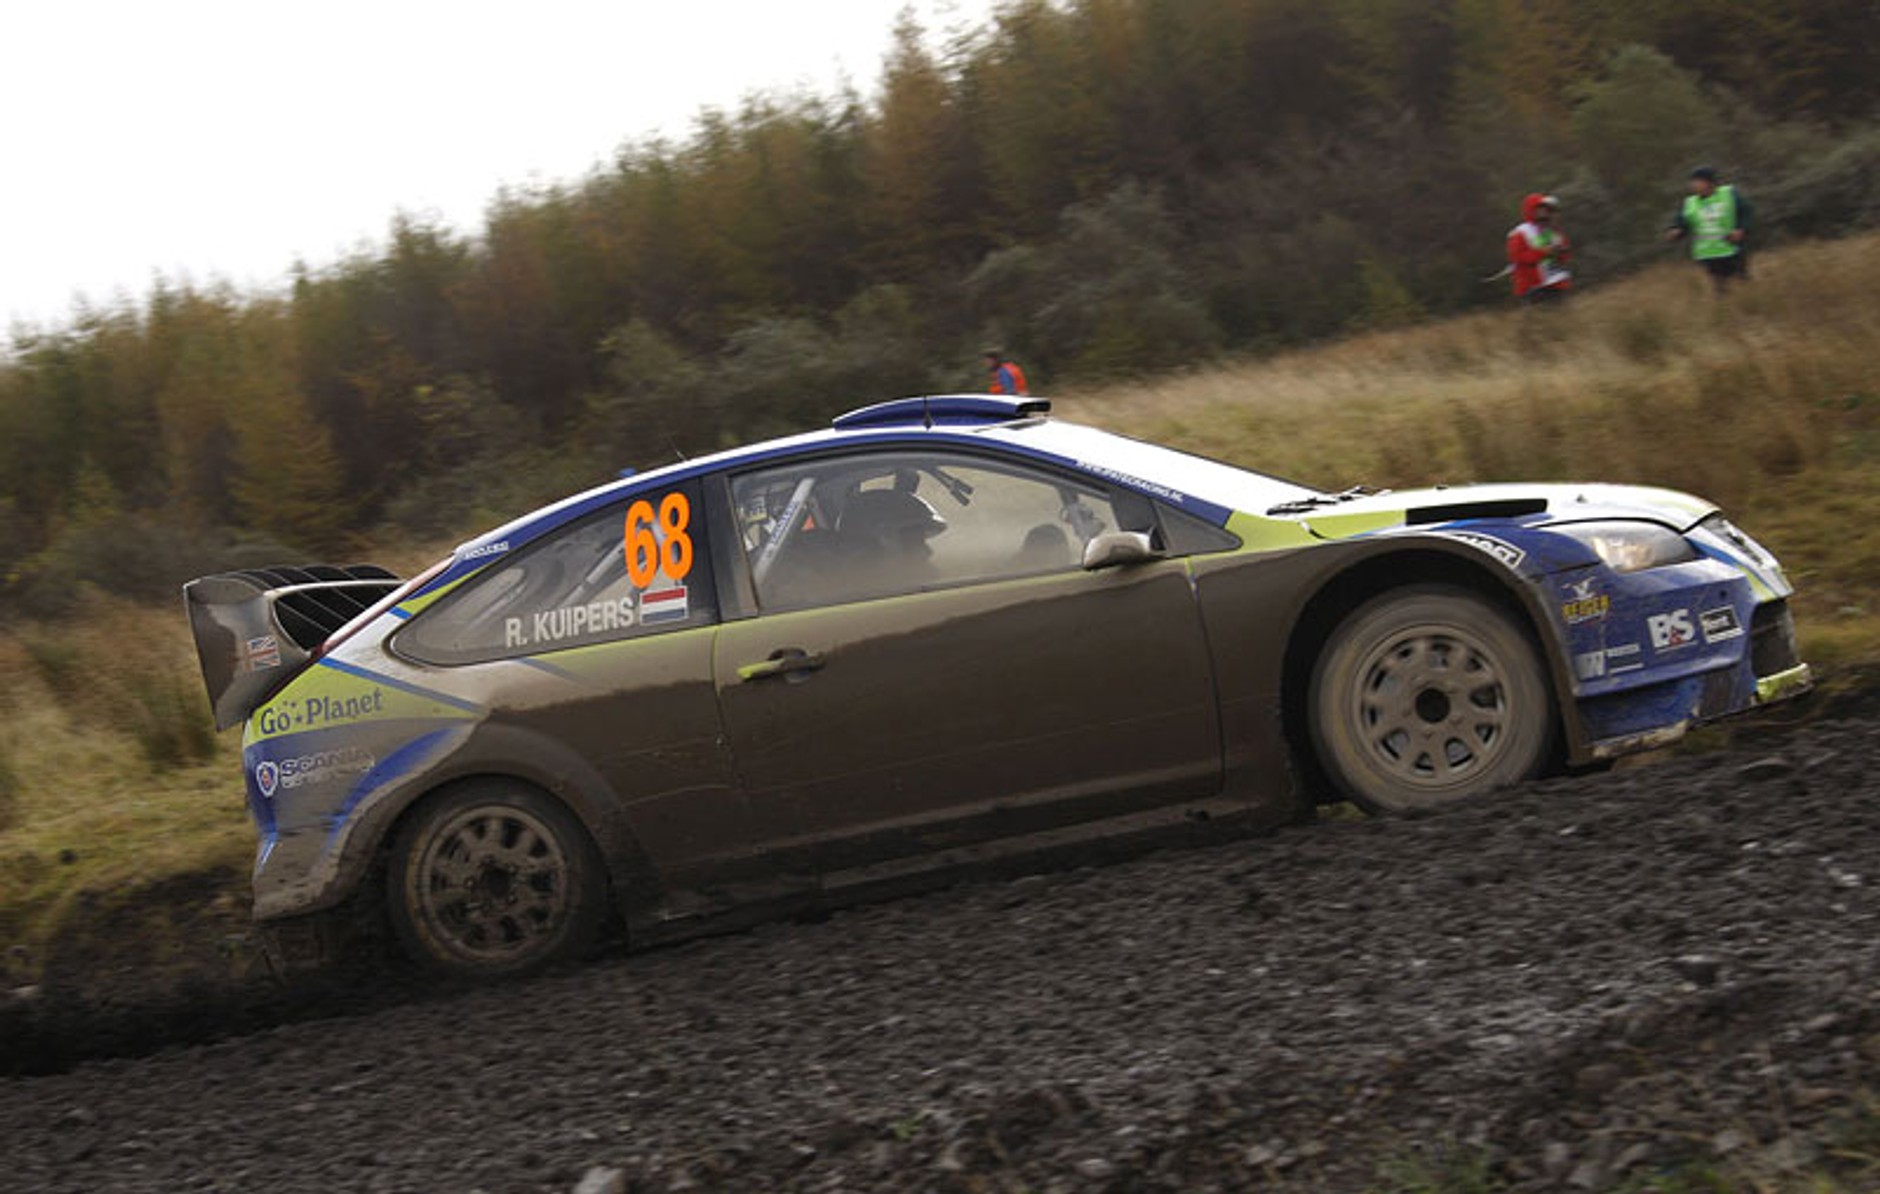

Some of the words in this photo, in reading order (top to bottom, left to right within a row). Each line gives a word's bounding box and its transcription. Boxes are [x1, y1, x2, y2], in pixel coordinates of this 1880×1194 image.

[624, 492, 694, 589] 68
[505, 617, 528, 647] R.
[533, 597, 635, 643] KUIPERS
[260, 707, 290, 735] Go
[306, 687, 383, 725] Planet
